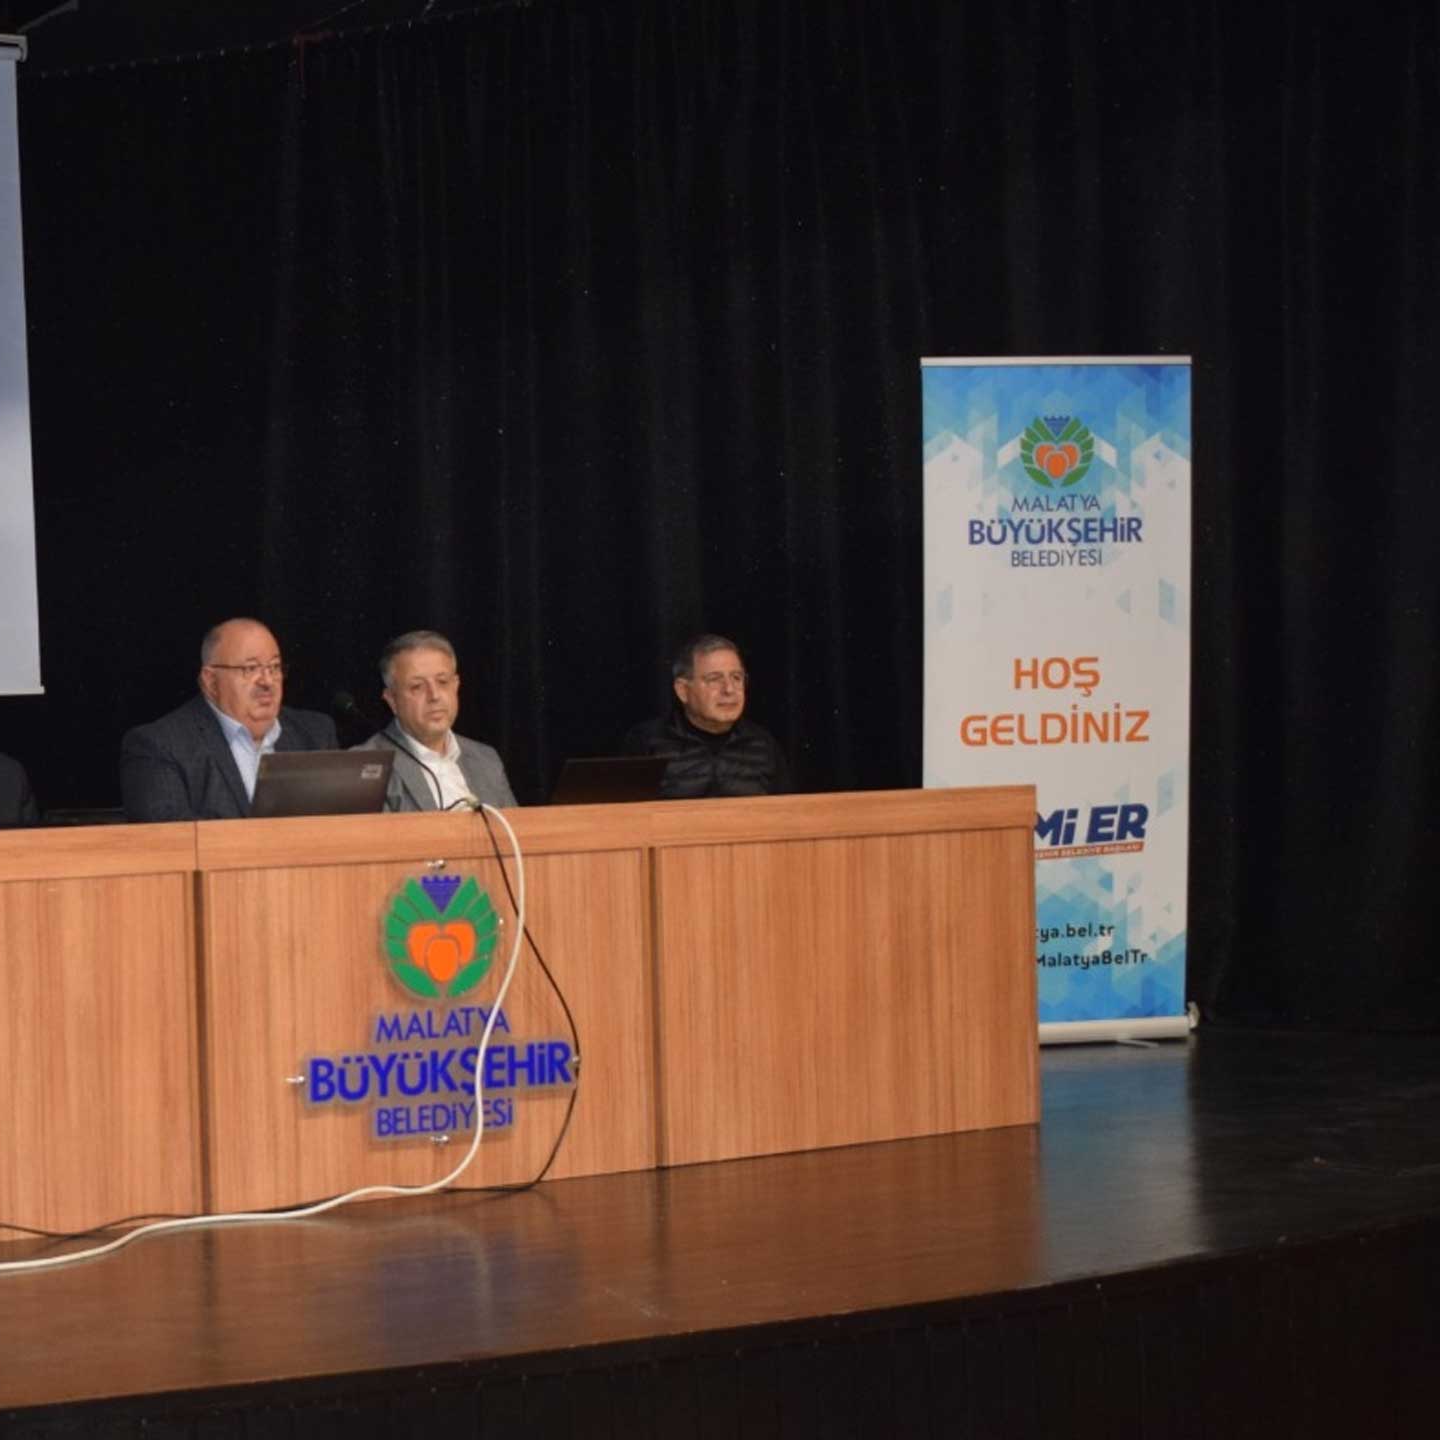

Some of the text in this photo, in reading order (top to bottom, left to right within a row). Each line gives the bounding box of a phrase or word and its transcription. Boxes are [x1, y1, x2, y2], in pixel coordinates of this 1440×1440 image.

[1011, 493, 1101, 514] MALATYA
[1013, 657, 1100, 698] HOŞ
[960, 703, 1150, 747] GELDİNİZ
[1086, 803, 1149, 844] ER
[1036, 922, 1115, 942] ya.bel.tr
[376, 1007, 510, 1043] MALATYA
